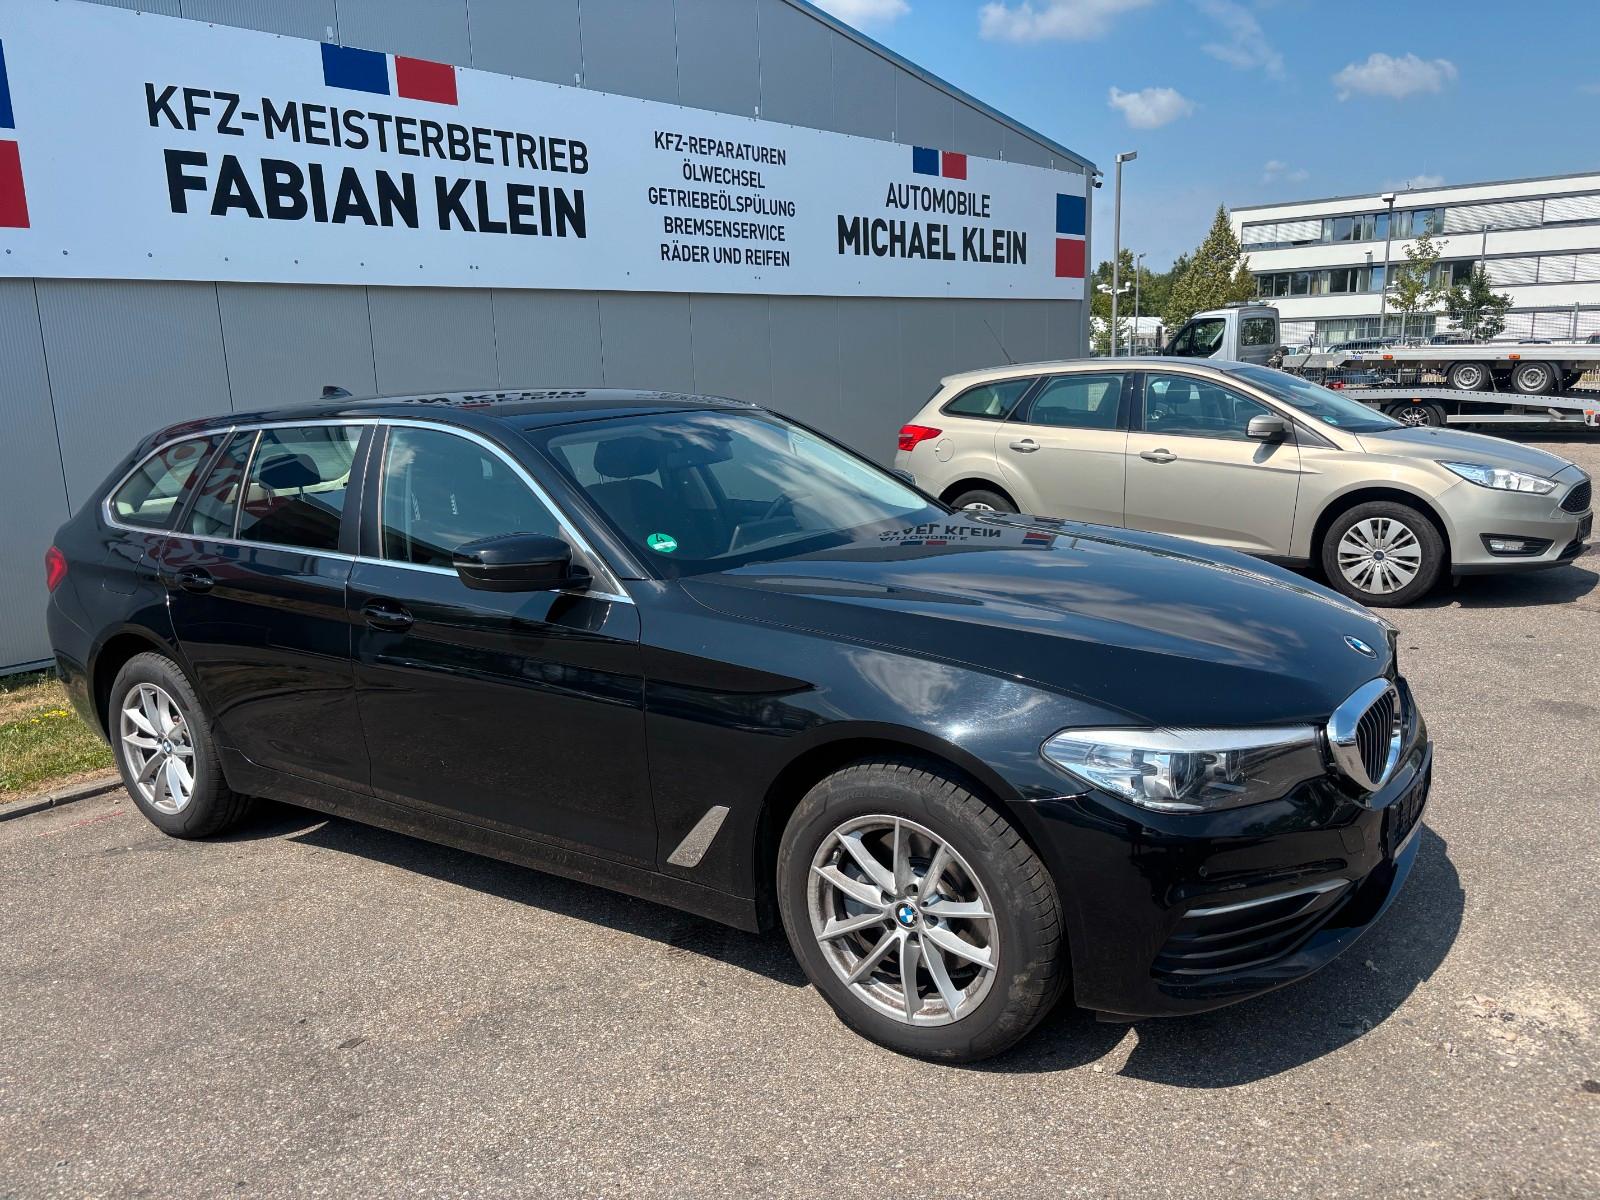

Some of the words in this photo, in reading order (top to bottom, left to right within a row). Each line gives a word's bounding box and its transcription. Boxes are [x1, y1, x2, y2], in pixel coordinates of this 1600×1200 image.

[145, 83, 588, 174] KFZ-MEISTERBETRIEB
[654, 131, 786, 165] KFZ-REPARATUREN
[682, 163, 765, 188] ÖLWECHSEL
[164, 149, 419, 229] FABIAN
[435, 176, 587, 238] KLEIN
[648, 187, 795, 217] GETRIEBEÖLSPÜLUNG
[886, 183, 991, 218] AUTOMOBILE
[664, 216, 785, 241] BREMSENSERVICE
[838, 215, 955, 260] MICHAEL
[963, 227, 1027, 264] KLEIN
[661, 241, 710, 263] RÄDER
[713, 247, 742, 264] UND
[745, 249, 790, 266] REIFEN
